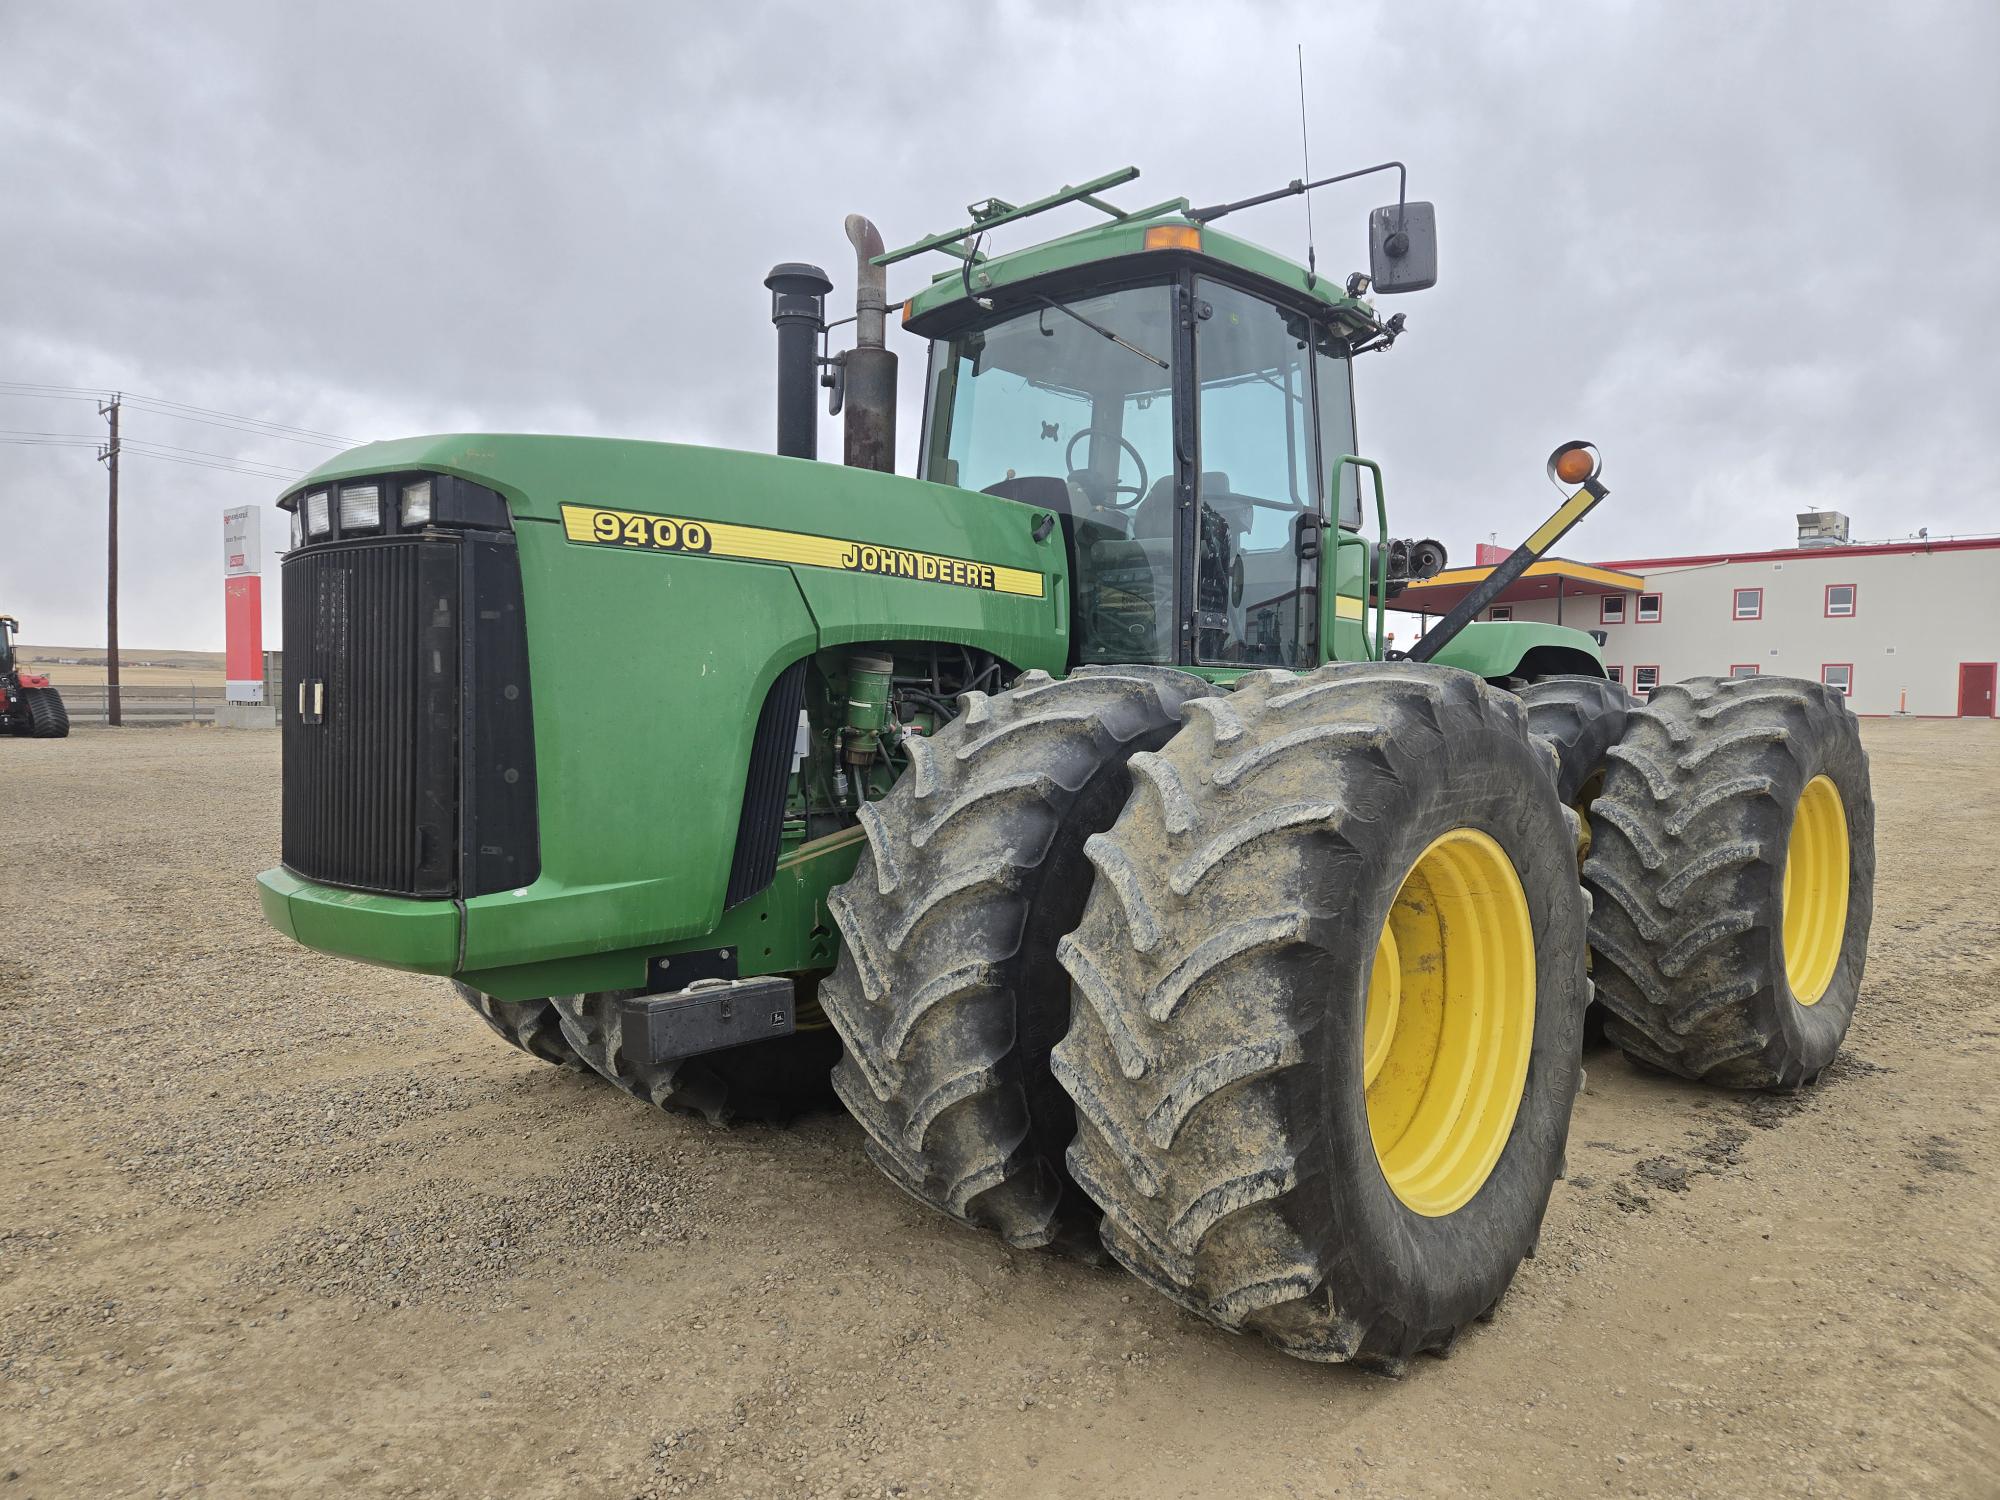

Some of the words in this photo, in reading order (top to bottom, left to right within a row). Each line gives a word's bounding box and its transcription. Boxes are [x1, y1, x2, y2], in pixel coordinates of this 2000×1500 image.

[593, 512, 711, 553] 9400
[842, 544, 917, 580] JOHN
[922, 554, 995, 591] DEERE
